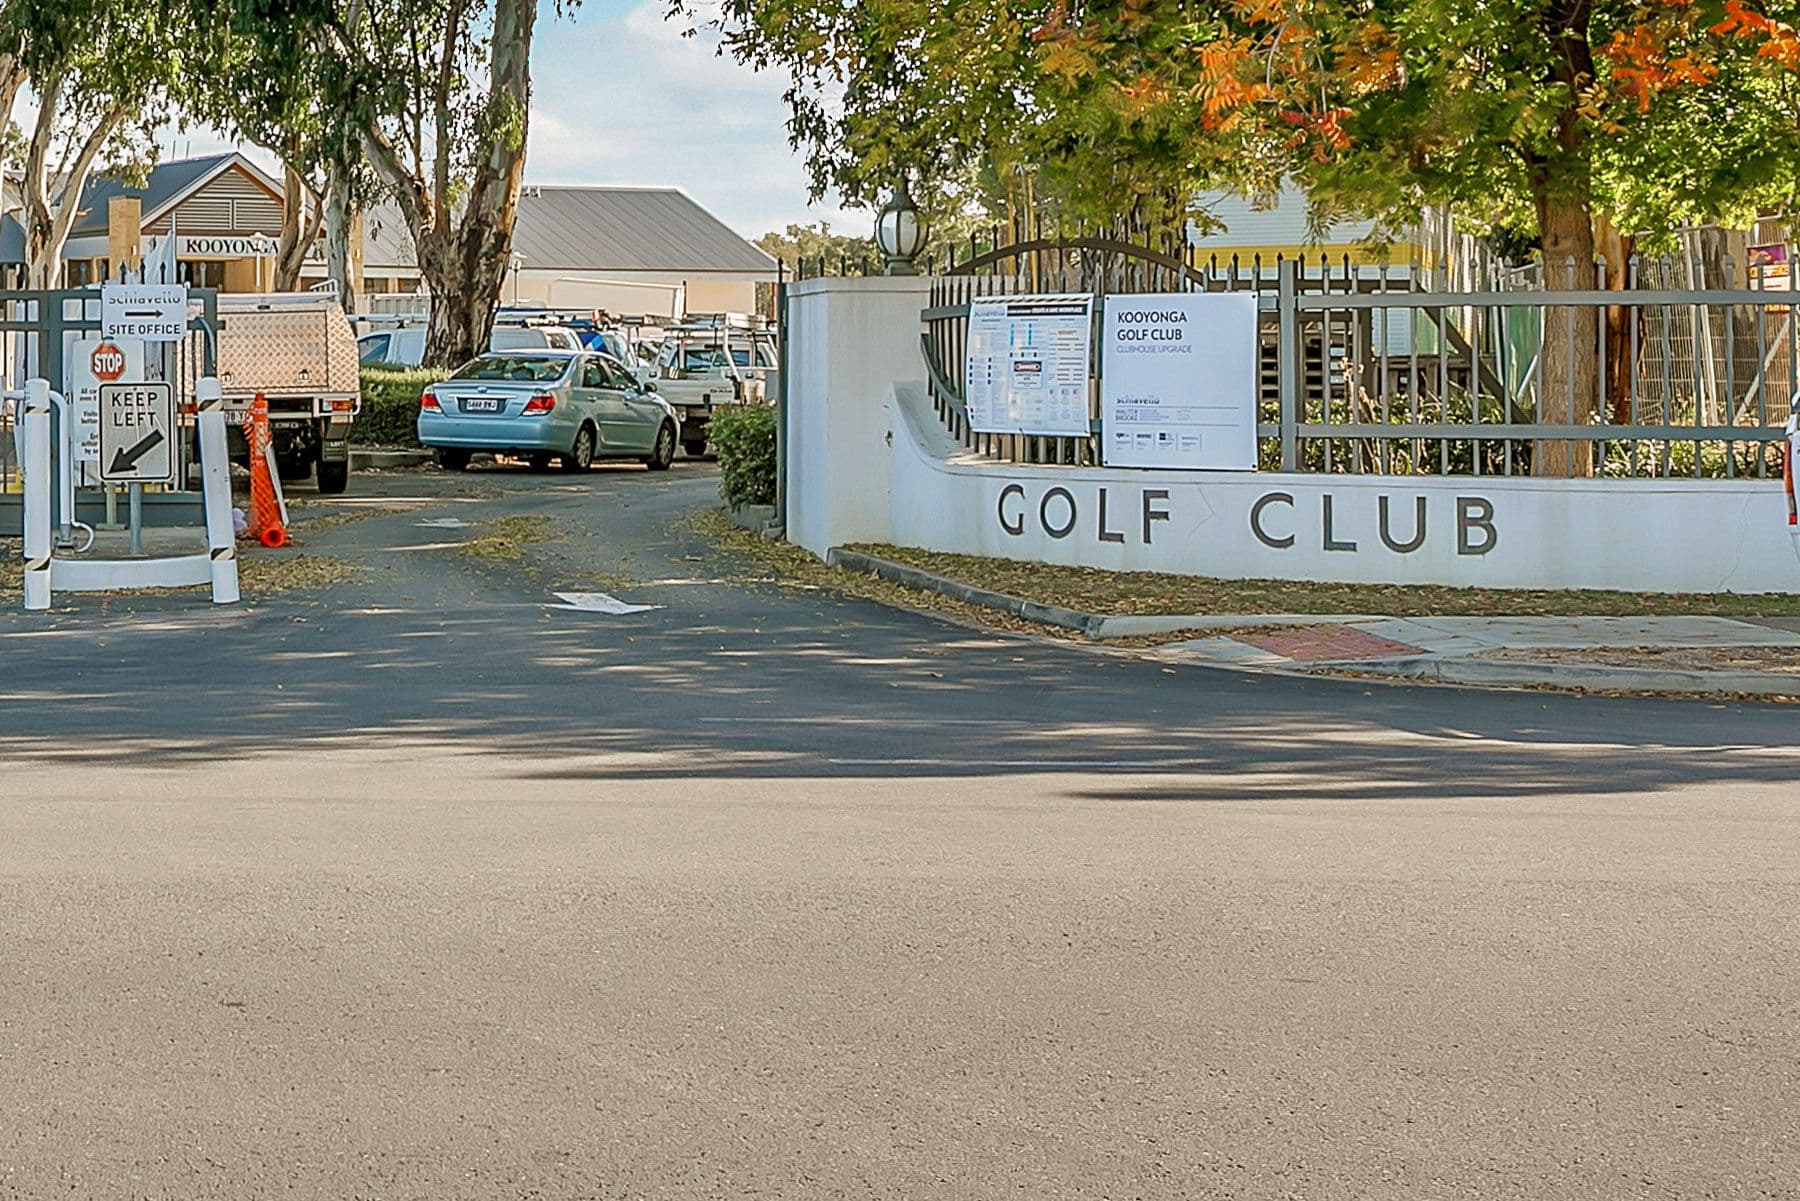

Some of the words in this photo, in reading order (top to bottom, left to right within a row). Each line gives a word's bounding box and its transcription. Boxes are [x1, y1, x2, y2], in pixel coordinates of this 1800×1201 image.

[186, 239, 279, 254] KOOYONGA
[1117, 311, 1187, 323] KOOYONGA
[109, 324, 135, 335] SITE
[138, 324, 181, 335] OFFICE
[1117, 329, 1148, 341] GOLF
[1151, 329, 1182, 341] CLUB
[94, 352, 123, 375] STOP
[112, 392, 158, 407] KEEP
[114, 412, 157, 427] LEFT
[998, 484, 1170, 544] GOLF
[1250, 492, 1498, 556] CLUB
